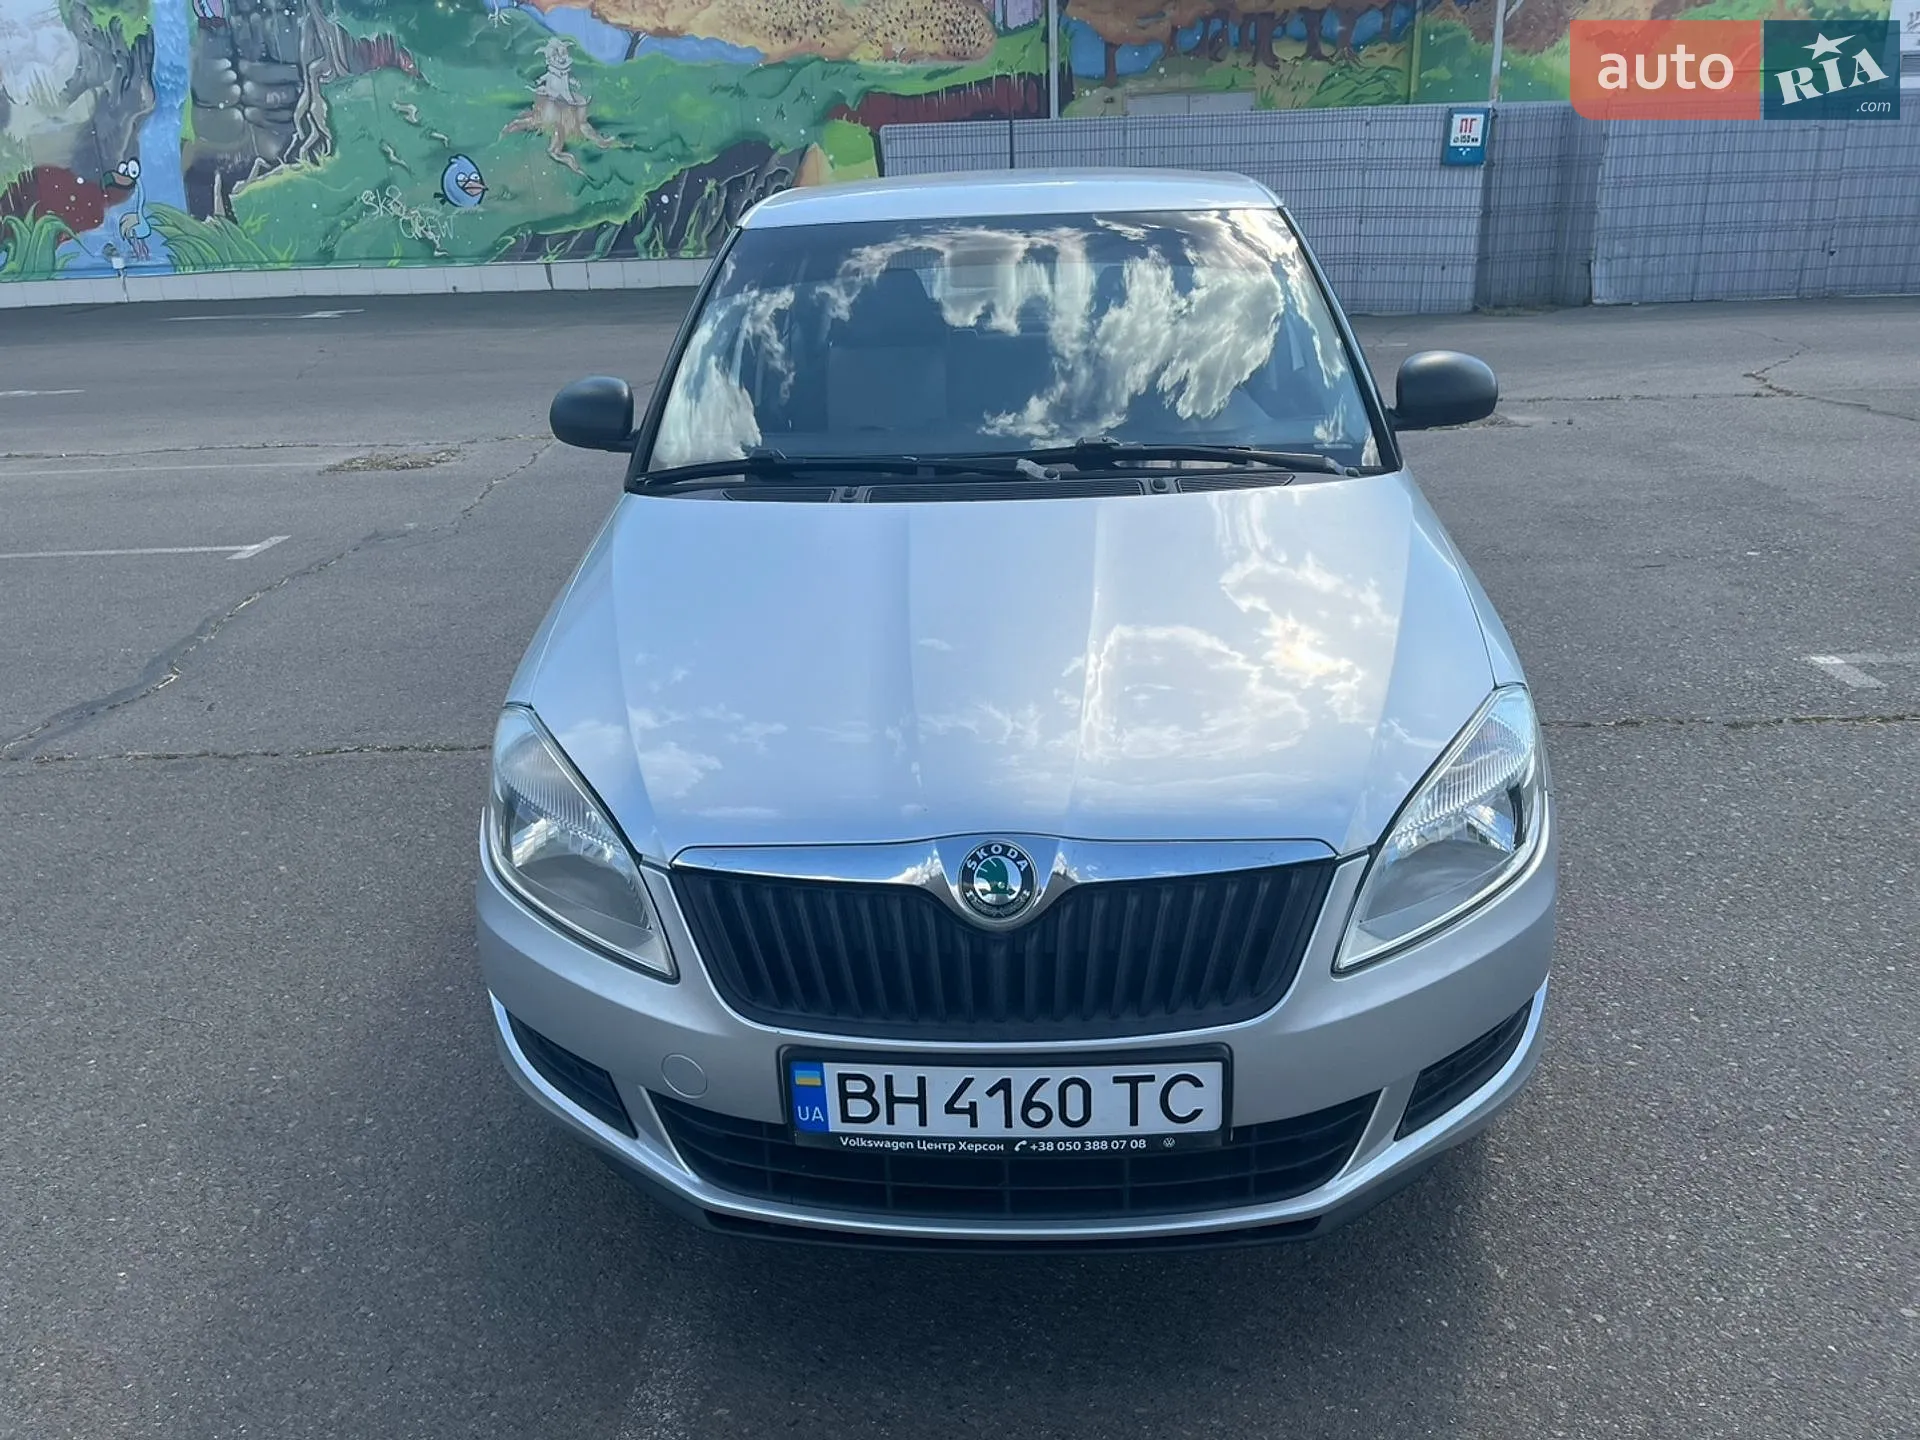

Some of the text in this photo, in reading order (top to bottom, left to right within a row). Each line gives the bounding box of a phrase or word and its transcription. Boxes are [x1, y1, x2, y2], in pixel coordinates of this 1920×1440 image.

[837, 1072, 1205, 1129] BH 4160 TC
[797, 1106, 825, 1122] UA
[839, 1136, 1004, 1153] Volkswagen Центр Херсон
[1030, 1138, 1147, 1152] +38 050 388 07 08
